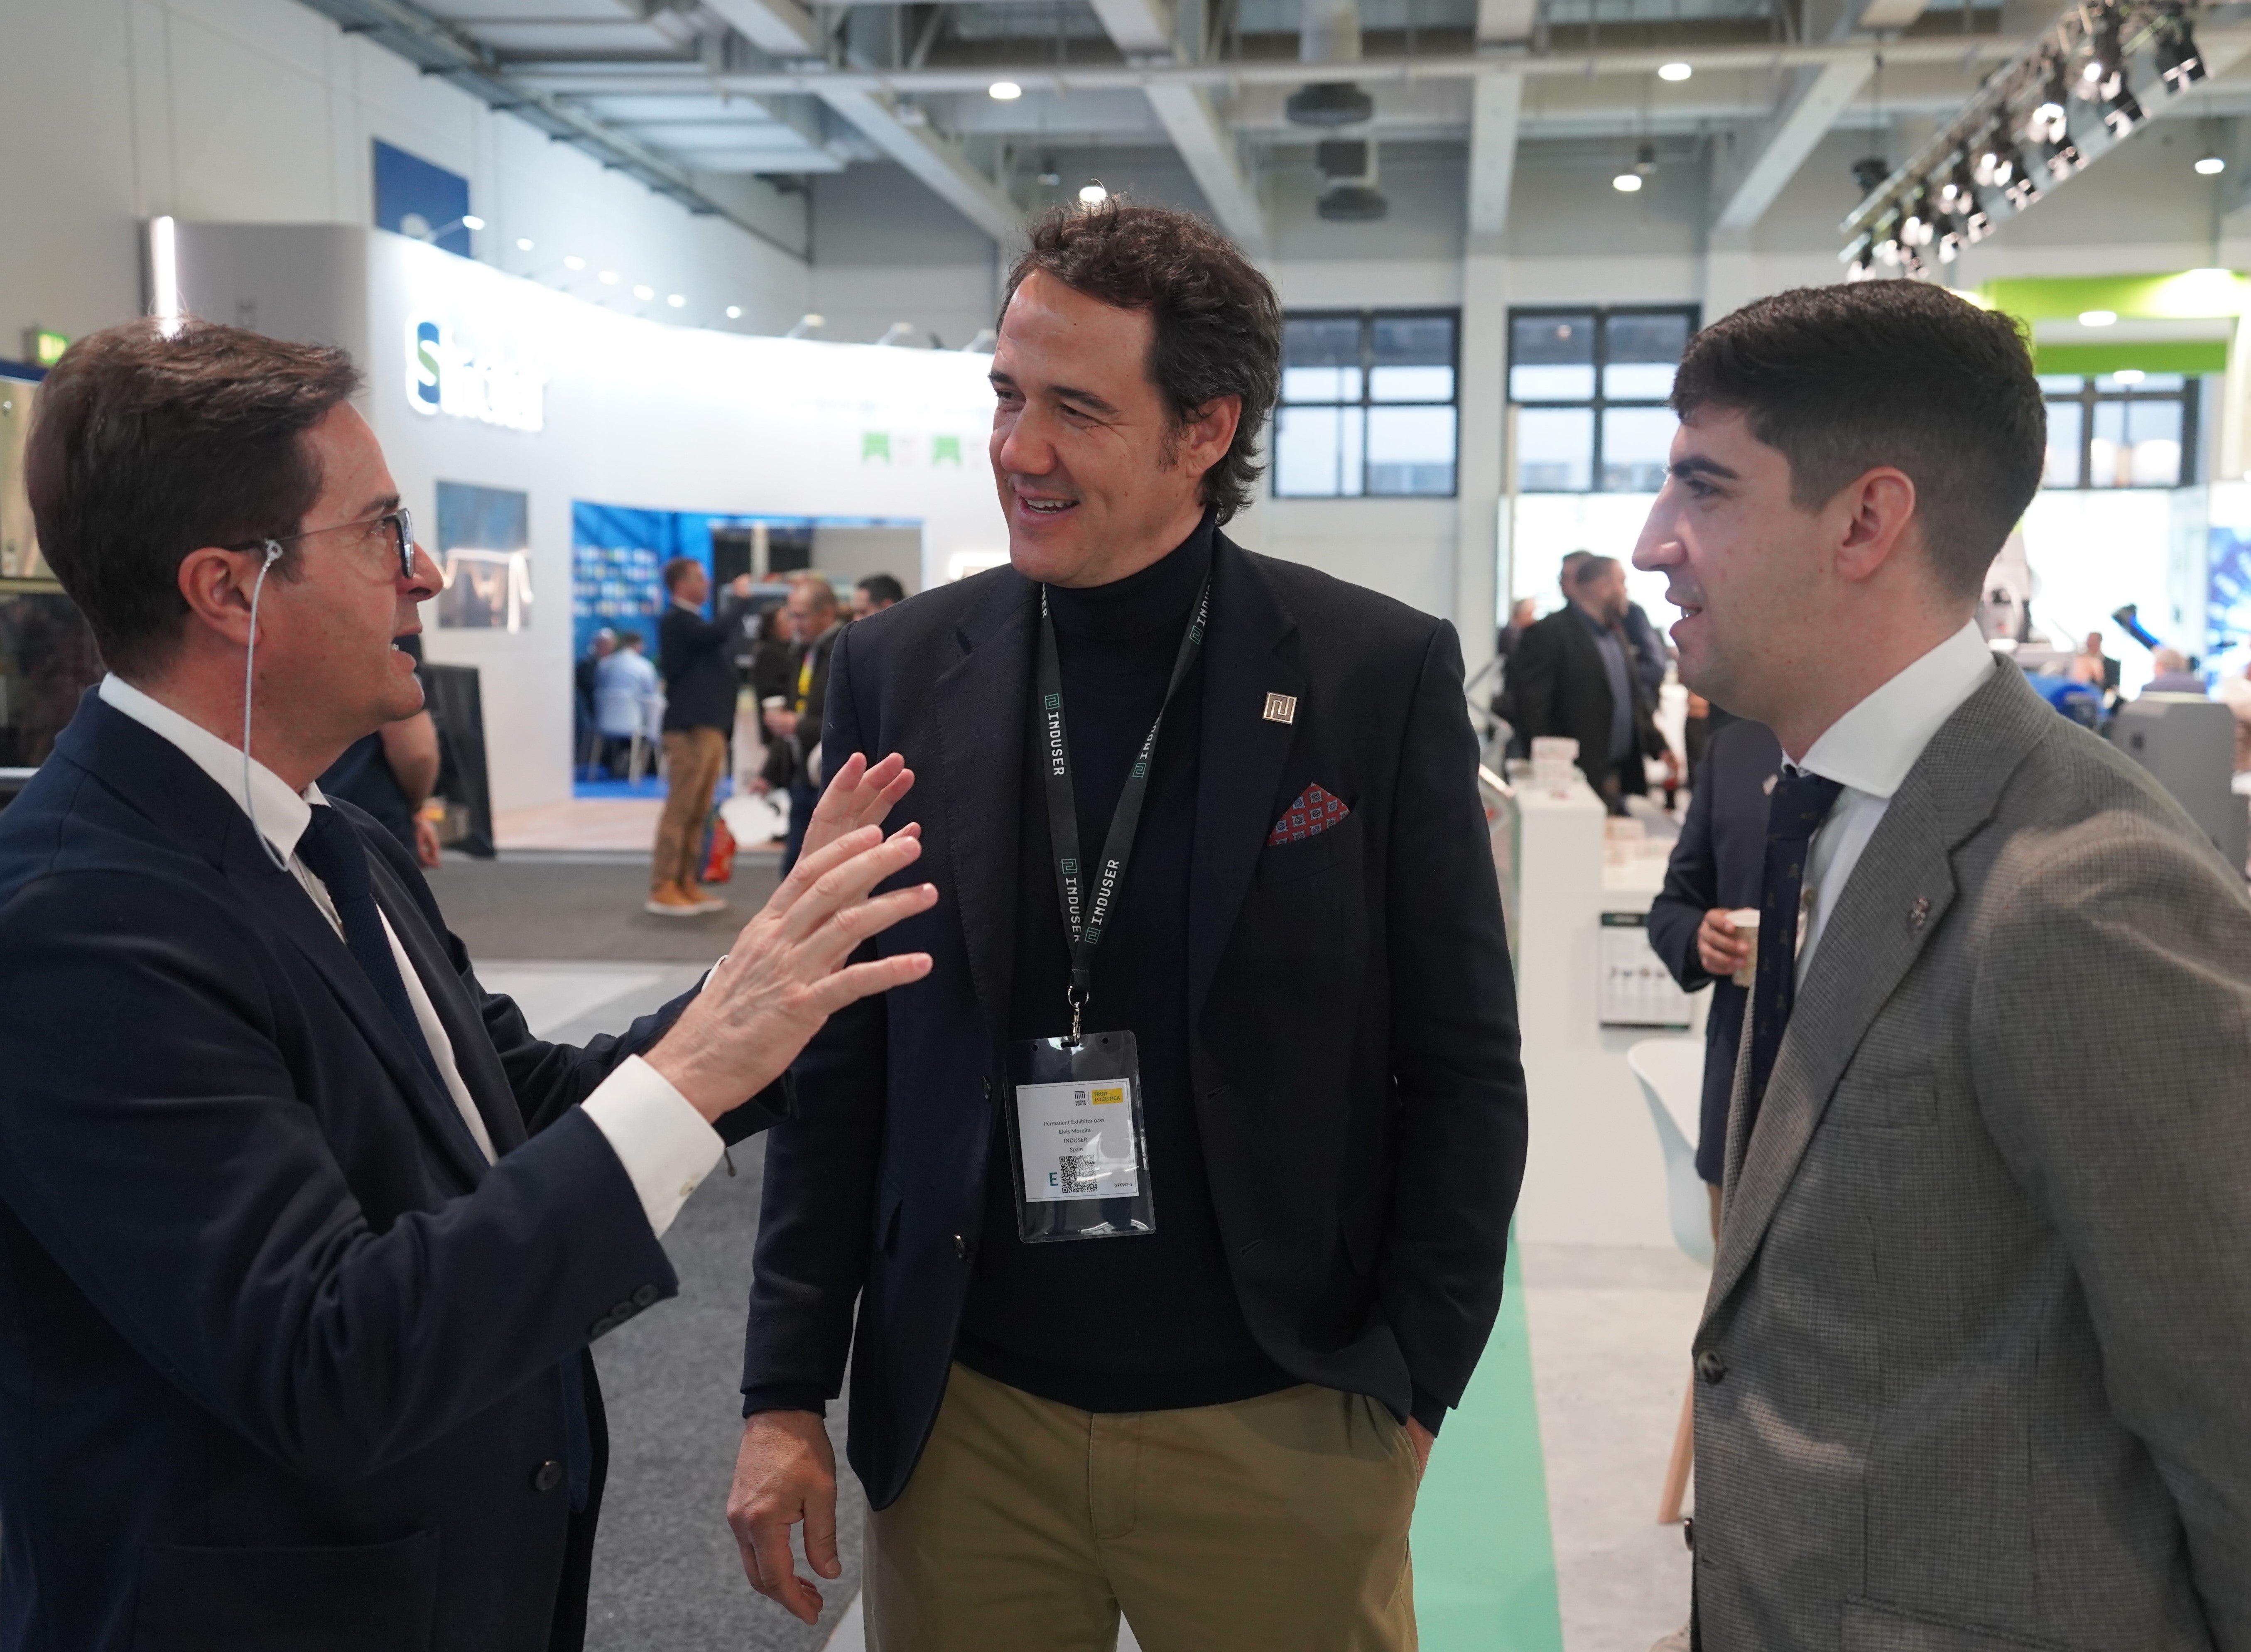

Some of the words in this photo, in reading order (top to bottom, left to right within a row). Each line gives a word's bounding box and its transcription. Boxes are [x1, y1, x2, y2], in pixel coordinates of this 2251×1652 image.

[1048, 711, 1065, 776] INDUSER
[1091, 859, 1120, 926] INDUSER
[1049, 1172, 1059, 1186] E
